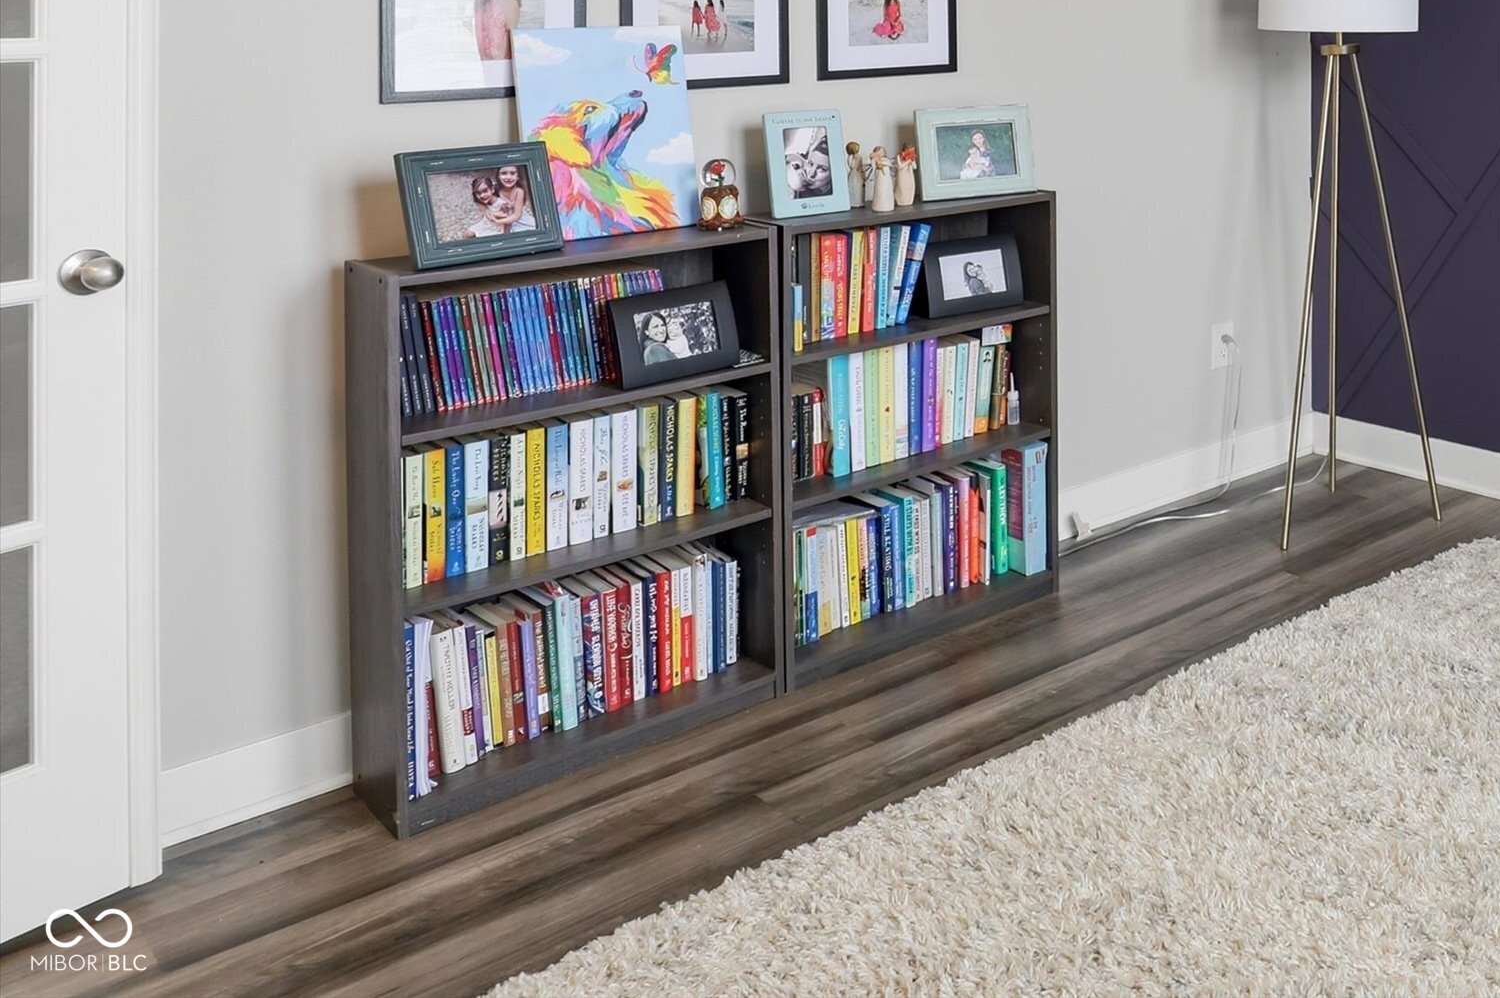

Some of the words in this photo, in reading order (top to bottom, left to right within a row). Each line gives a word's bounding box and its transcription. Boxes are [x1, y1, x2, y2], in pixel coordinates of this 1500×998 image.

[666, 405, 674, 452] NICHOLAS
[450, 467, 460, 487] Lucky
[533, 443, 541, 489] NICHOLAS
[452, 489, 460, 505] One
[884, 536, 892, 571] BEATING
[443, 644, 452, 680] TIMOTHY
[446, 681, 455, 711] KELLER
